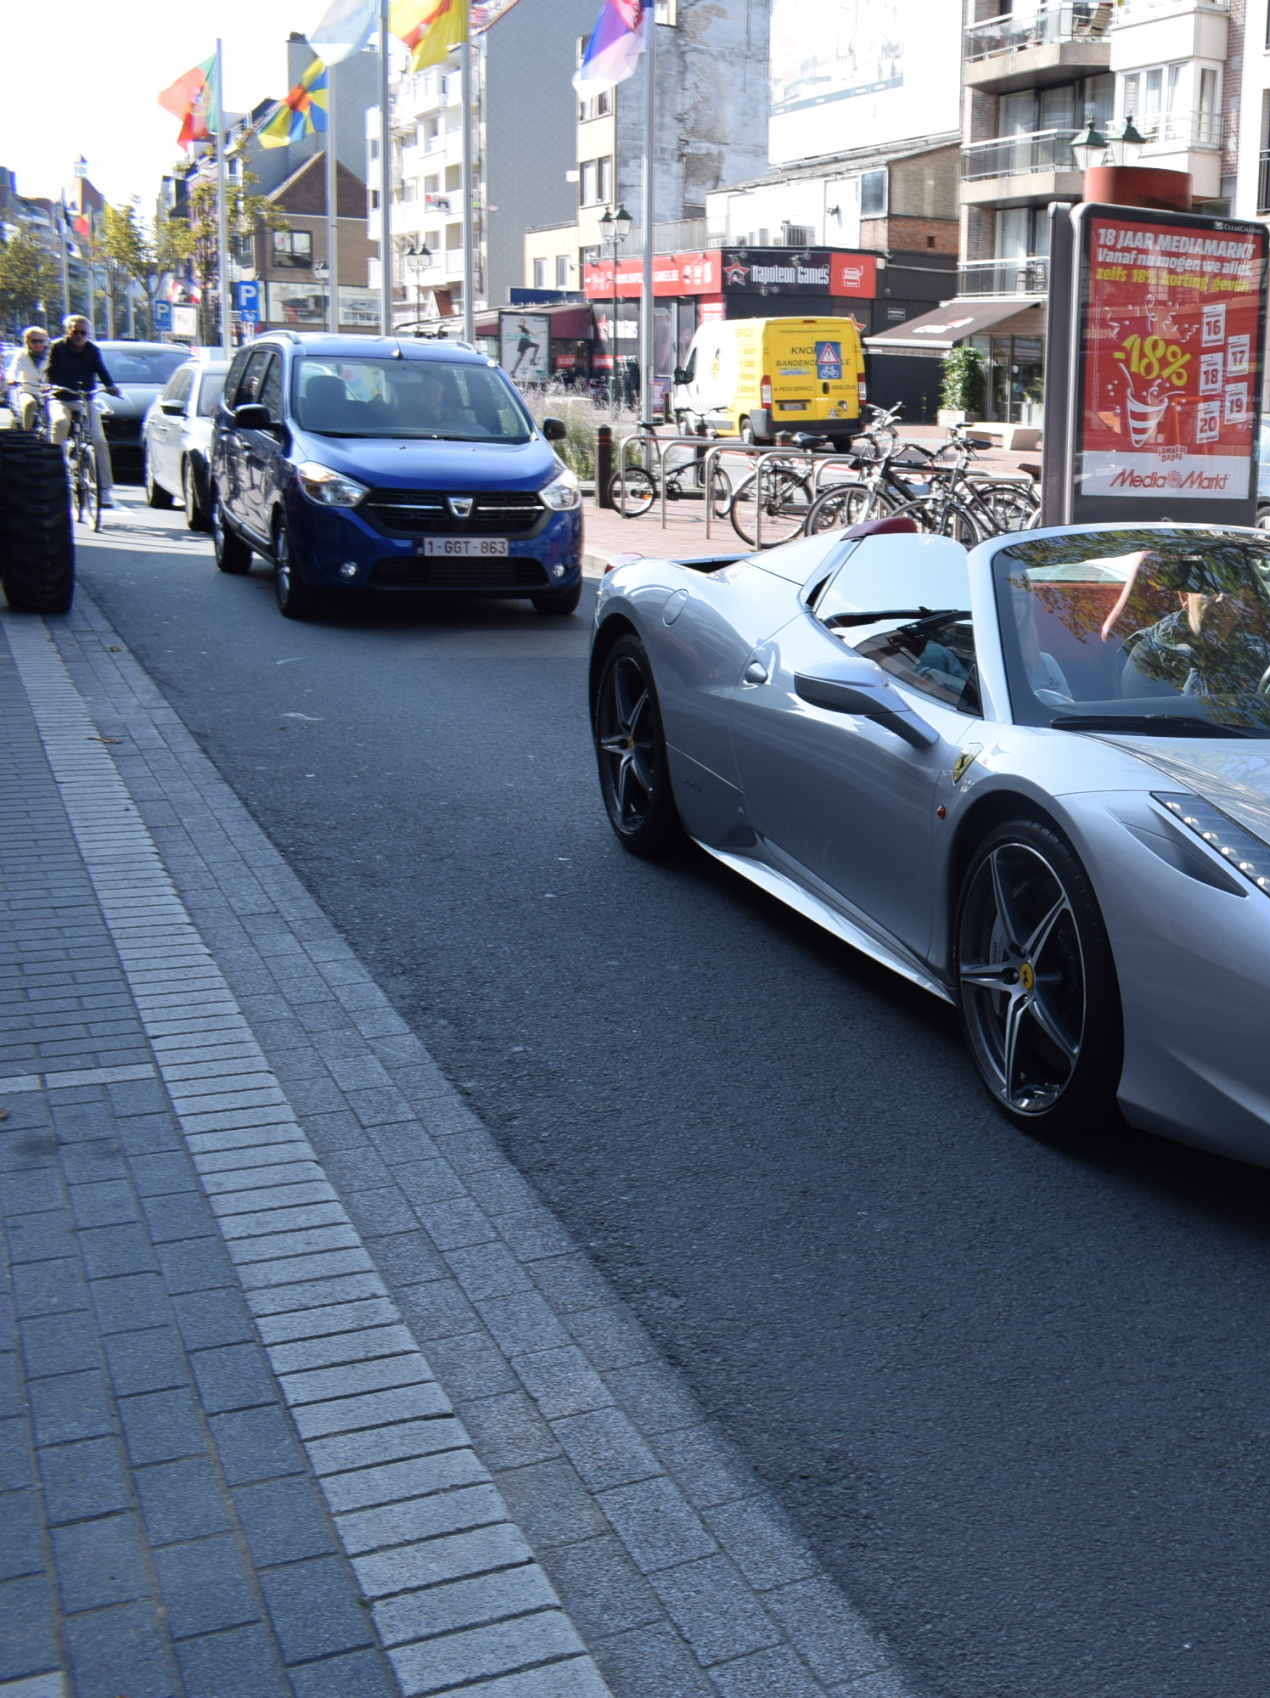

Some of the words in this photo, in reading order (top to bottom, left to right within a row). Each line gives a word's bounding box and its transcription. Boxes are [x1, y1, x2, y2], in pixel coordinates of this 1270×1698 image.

[1098, 228, 1116, 246] 18
[1117, 230, 1154, 250] JAAR
[1156, 234, 1256, 260] MEDIAMARKT
[1096, 247, 1136, 264] Vanaf
[1137, 254, 1154, 266] nu
[1156, 256, 1200, 272] mogen
[1202, 260, 1220, 273] we
[797, 266, 830, 285] Games
[1096, 266, 1128, 282] zelfs
[1132, 268, 1156, 284] 18%
[1158, 273, 1209, 292] korting
[240, 286, 256, 306] P
[156, 304, 168, 319] P
[1206, 319, 1221, 336] 16
[1113, 334, 1192, 386] -18%
[1231, 350, 1246, 367] 17
[1203, 368, 1219, 386] 18
[1228, 398, 1244, 415] 19
[1199, 416, 1217, 434] 20
[1109, 468, 1166, 488] Media
[1178, 470, 1230, 490] Markt
[428, 541, 506, 554] 1-GGT-863
